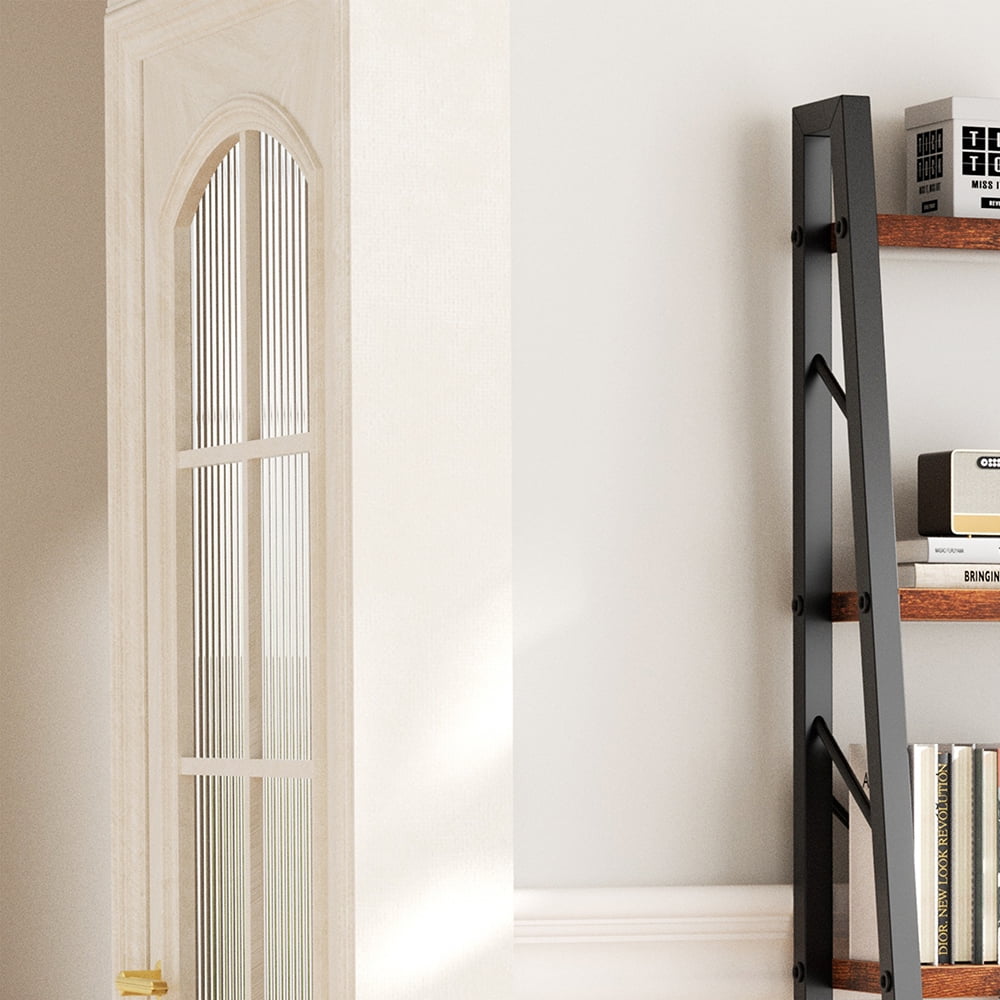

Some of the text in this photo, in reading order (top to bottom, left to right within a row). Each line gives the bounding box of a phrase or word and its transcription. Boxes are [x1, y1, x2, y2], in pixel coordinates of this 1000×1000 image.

[971, 180, 993, 190] MISS
[938, 763, 949, 956] DIOR. NEW LOOK REVOLUTION
